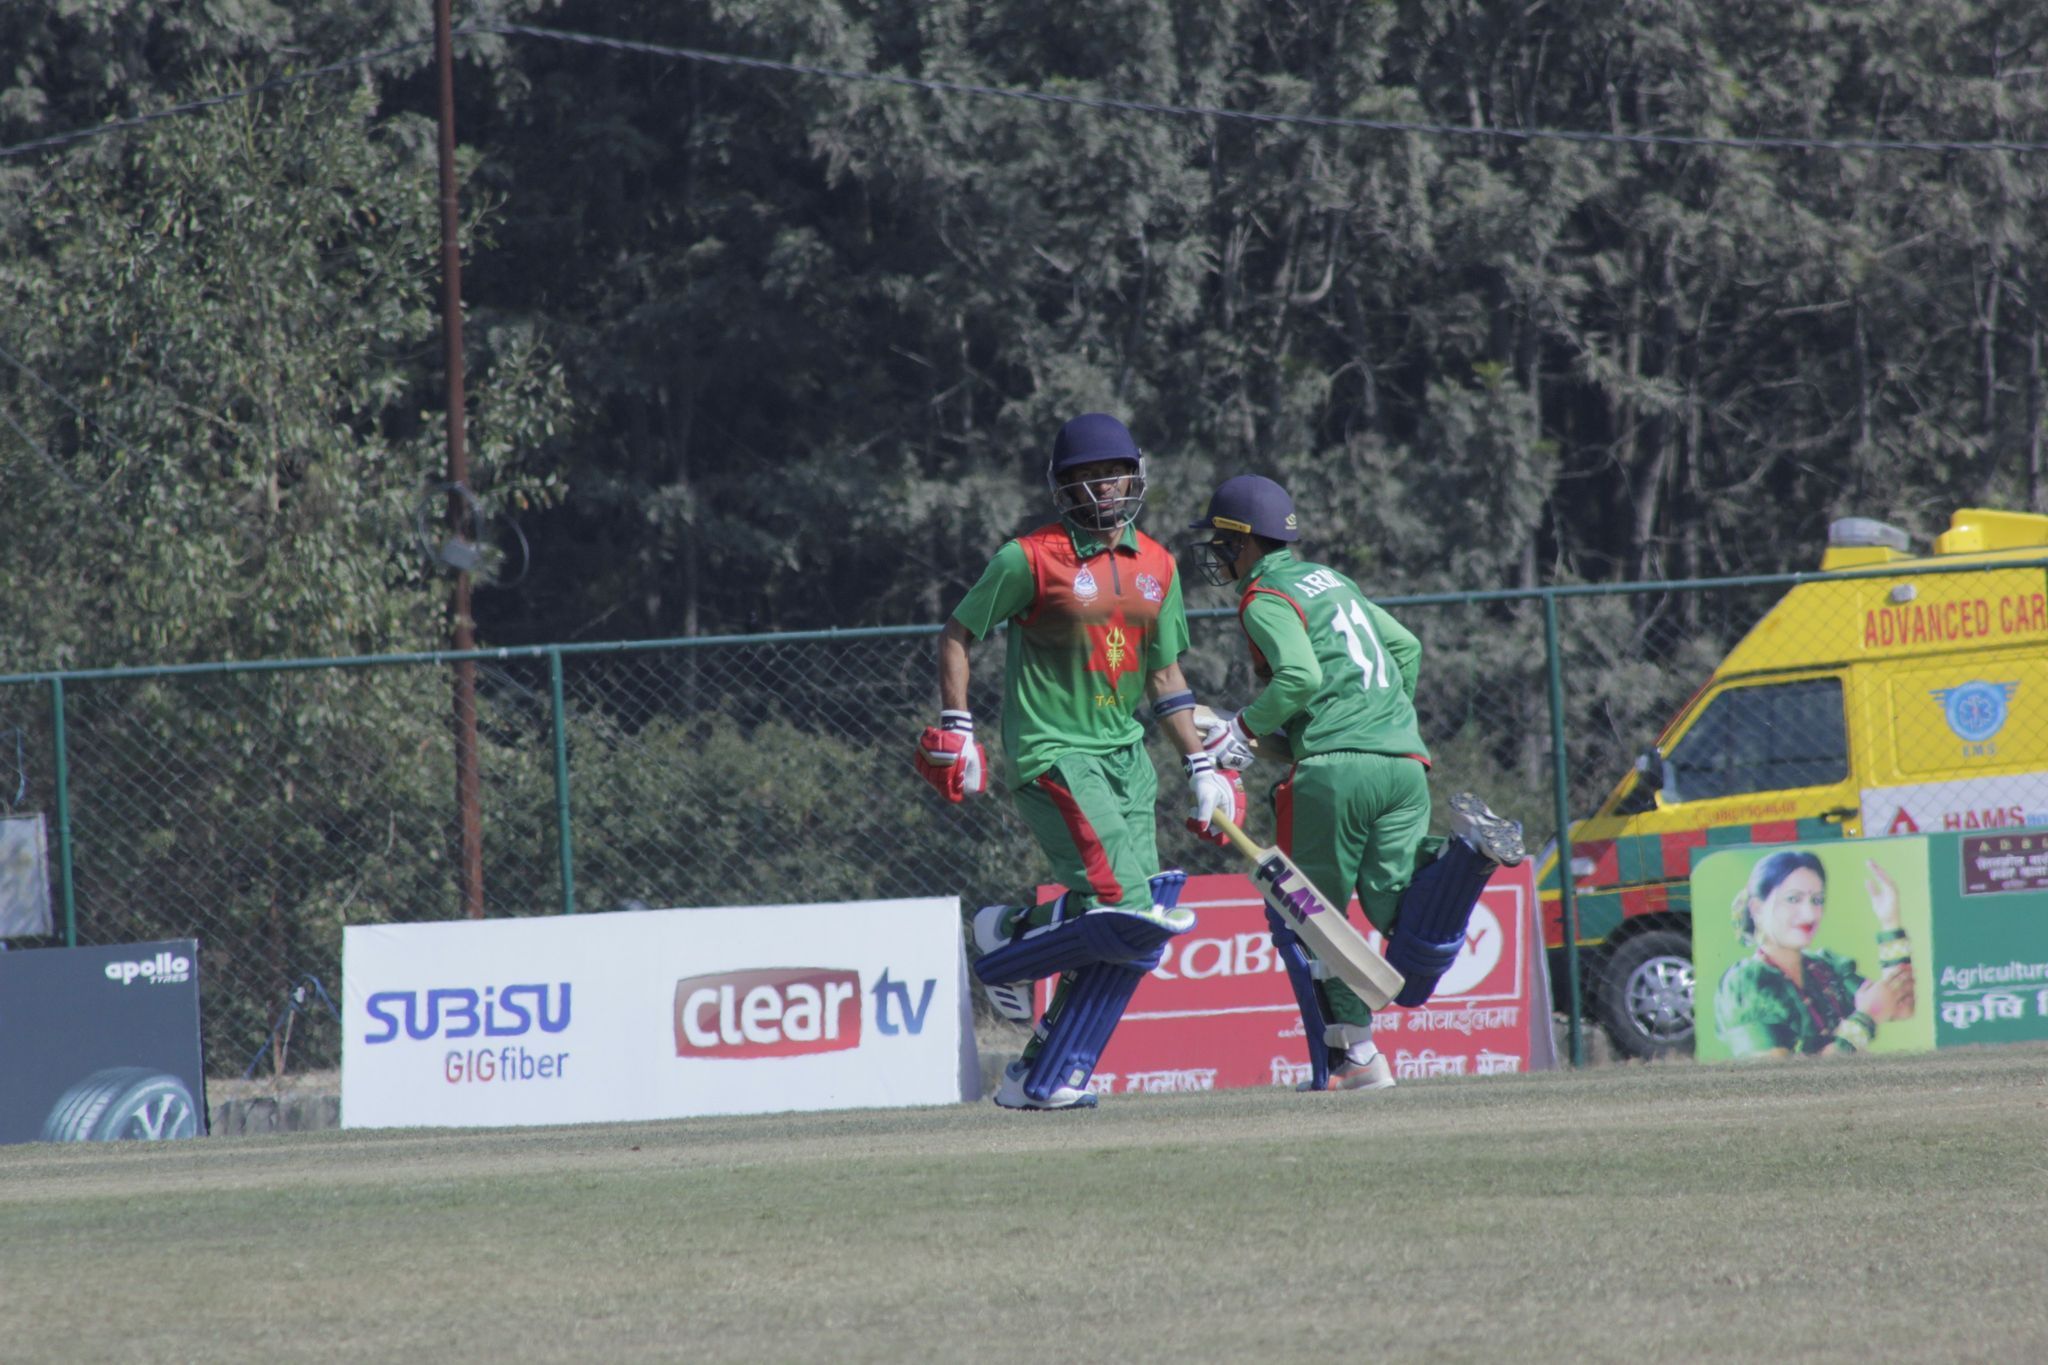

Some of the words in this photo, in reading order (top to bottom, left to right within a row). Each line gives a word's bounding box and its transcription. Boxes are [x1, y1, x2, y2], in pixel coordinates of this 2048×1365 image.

[1294, 569, 1346, 598] ARM
[1331, 599, 1389, 689] 11
[1865, 598, 1990, 648] ADVANCED
[1943, 805, 2025, 830] HAMS
[1256, 855, 1326, 925] PLAY
[105, 951, 190, 986] apollo
[681, 981, 853, 1048] clear
[870, 967, 938, 1036] tv
[445, 1047, 570, 1085] GIGfiber
